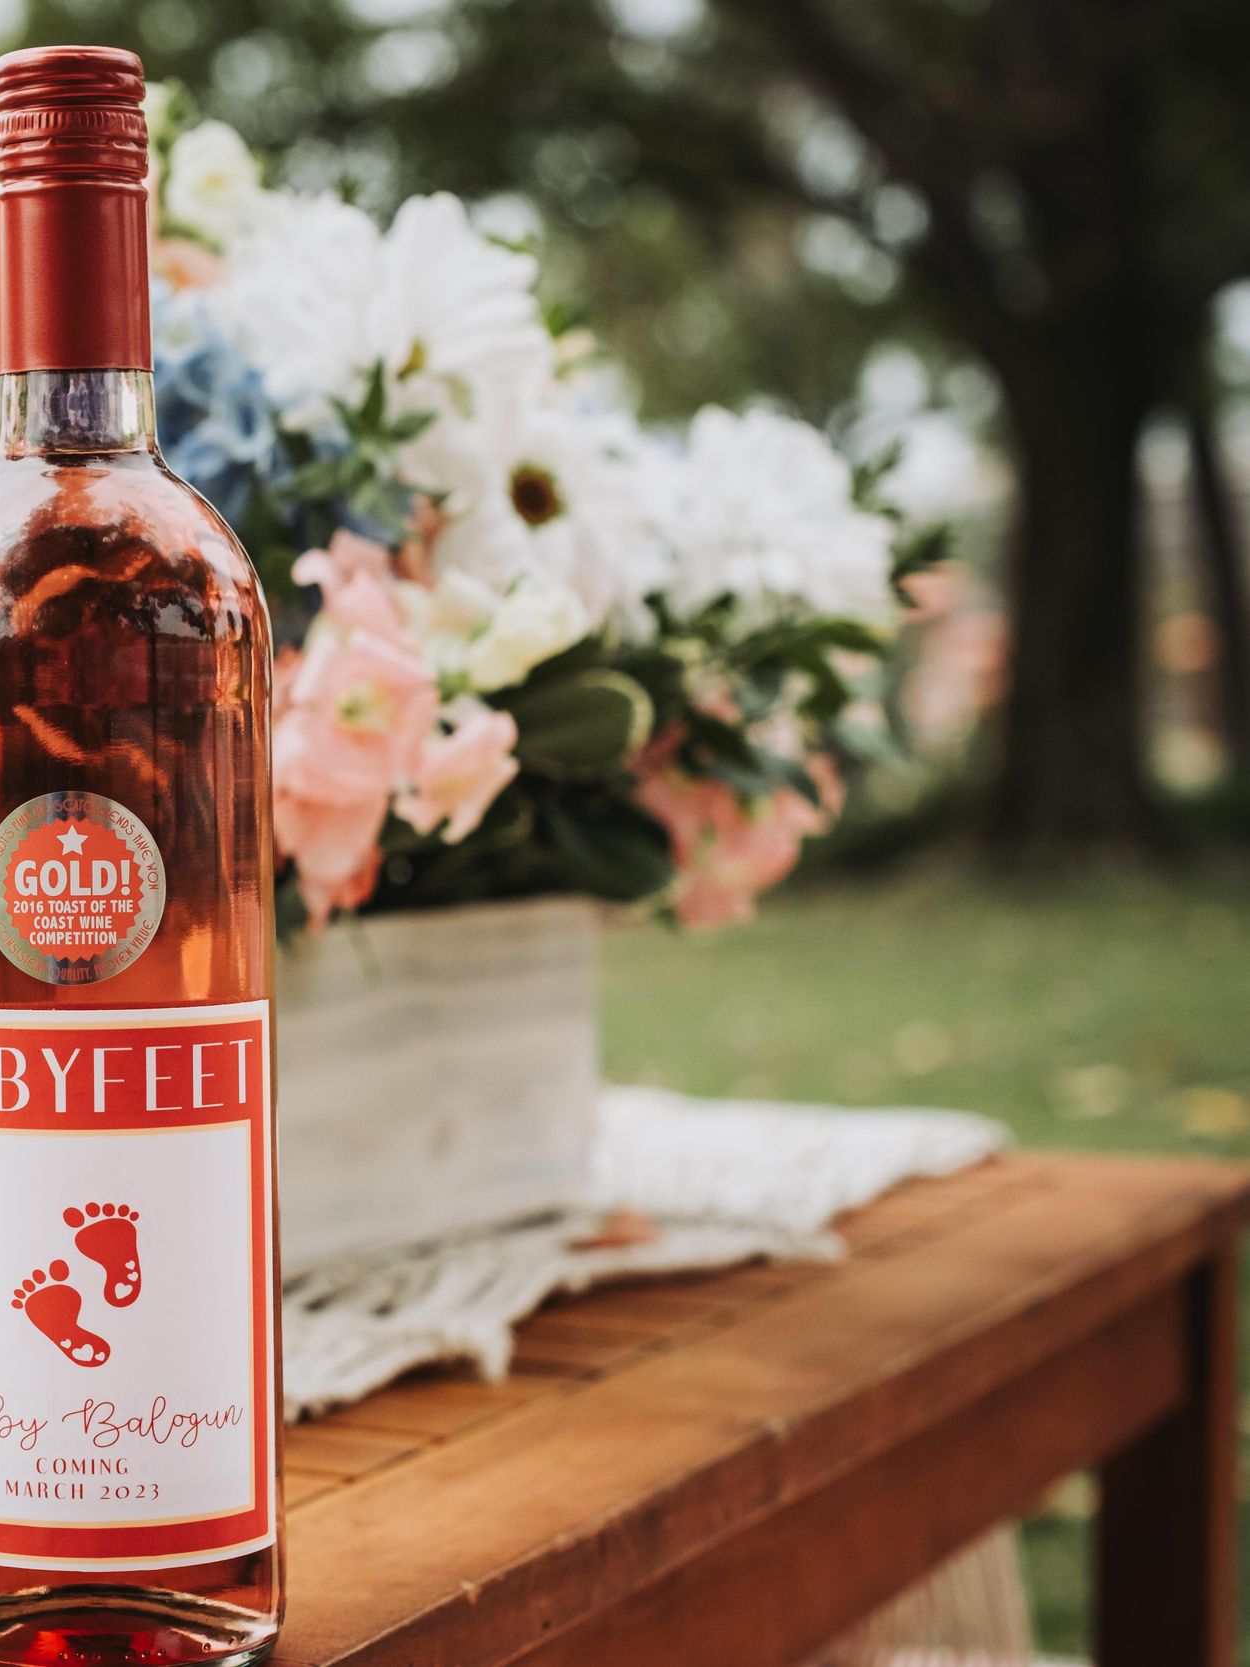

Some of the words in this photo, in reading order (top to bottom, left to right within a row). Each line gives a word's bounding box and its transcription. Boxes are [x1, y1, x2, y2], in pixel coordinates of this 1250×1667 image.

[132, 834, 153, 860] HAVE
[146, 862, 159, 890] WON
[15, 860, 130, 896] GOLD!
[14, 901, 43, 913] 2016
[48, 900, 86, 913] TOAST
[91, 900, 106, 913] OF
[110, 900, 133, 912] THE
[34, 916, 74, 929] COAST
[80, 916, 112, 929] WINE
[28, 932, 116, 946] COMPETITION
[130, 919, 154, 956] VALUE
[62, 1395, 243, 1449] Balogun
[36, 1456, 129, 1476] COMING
[5, 1480, 84, 1502] MARCH
[99, 1484, 158, 1503] 2023
